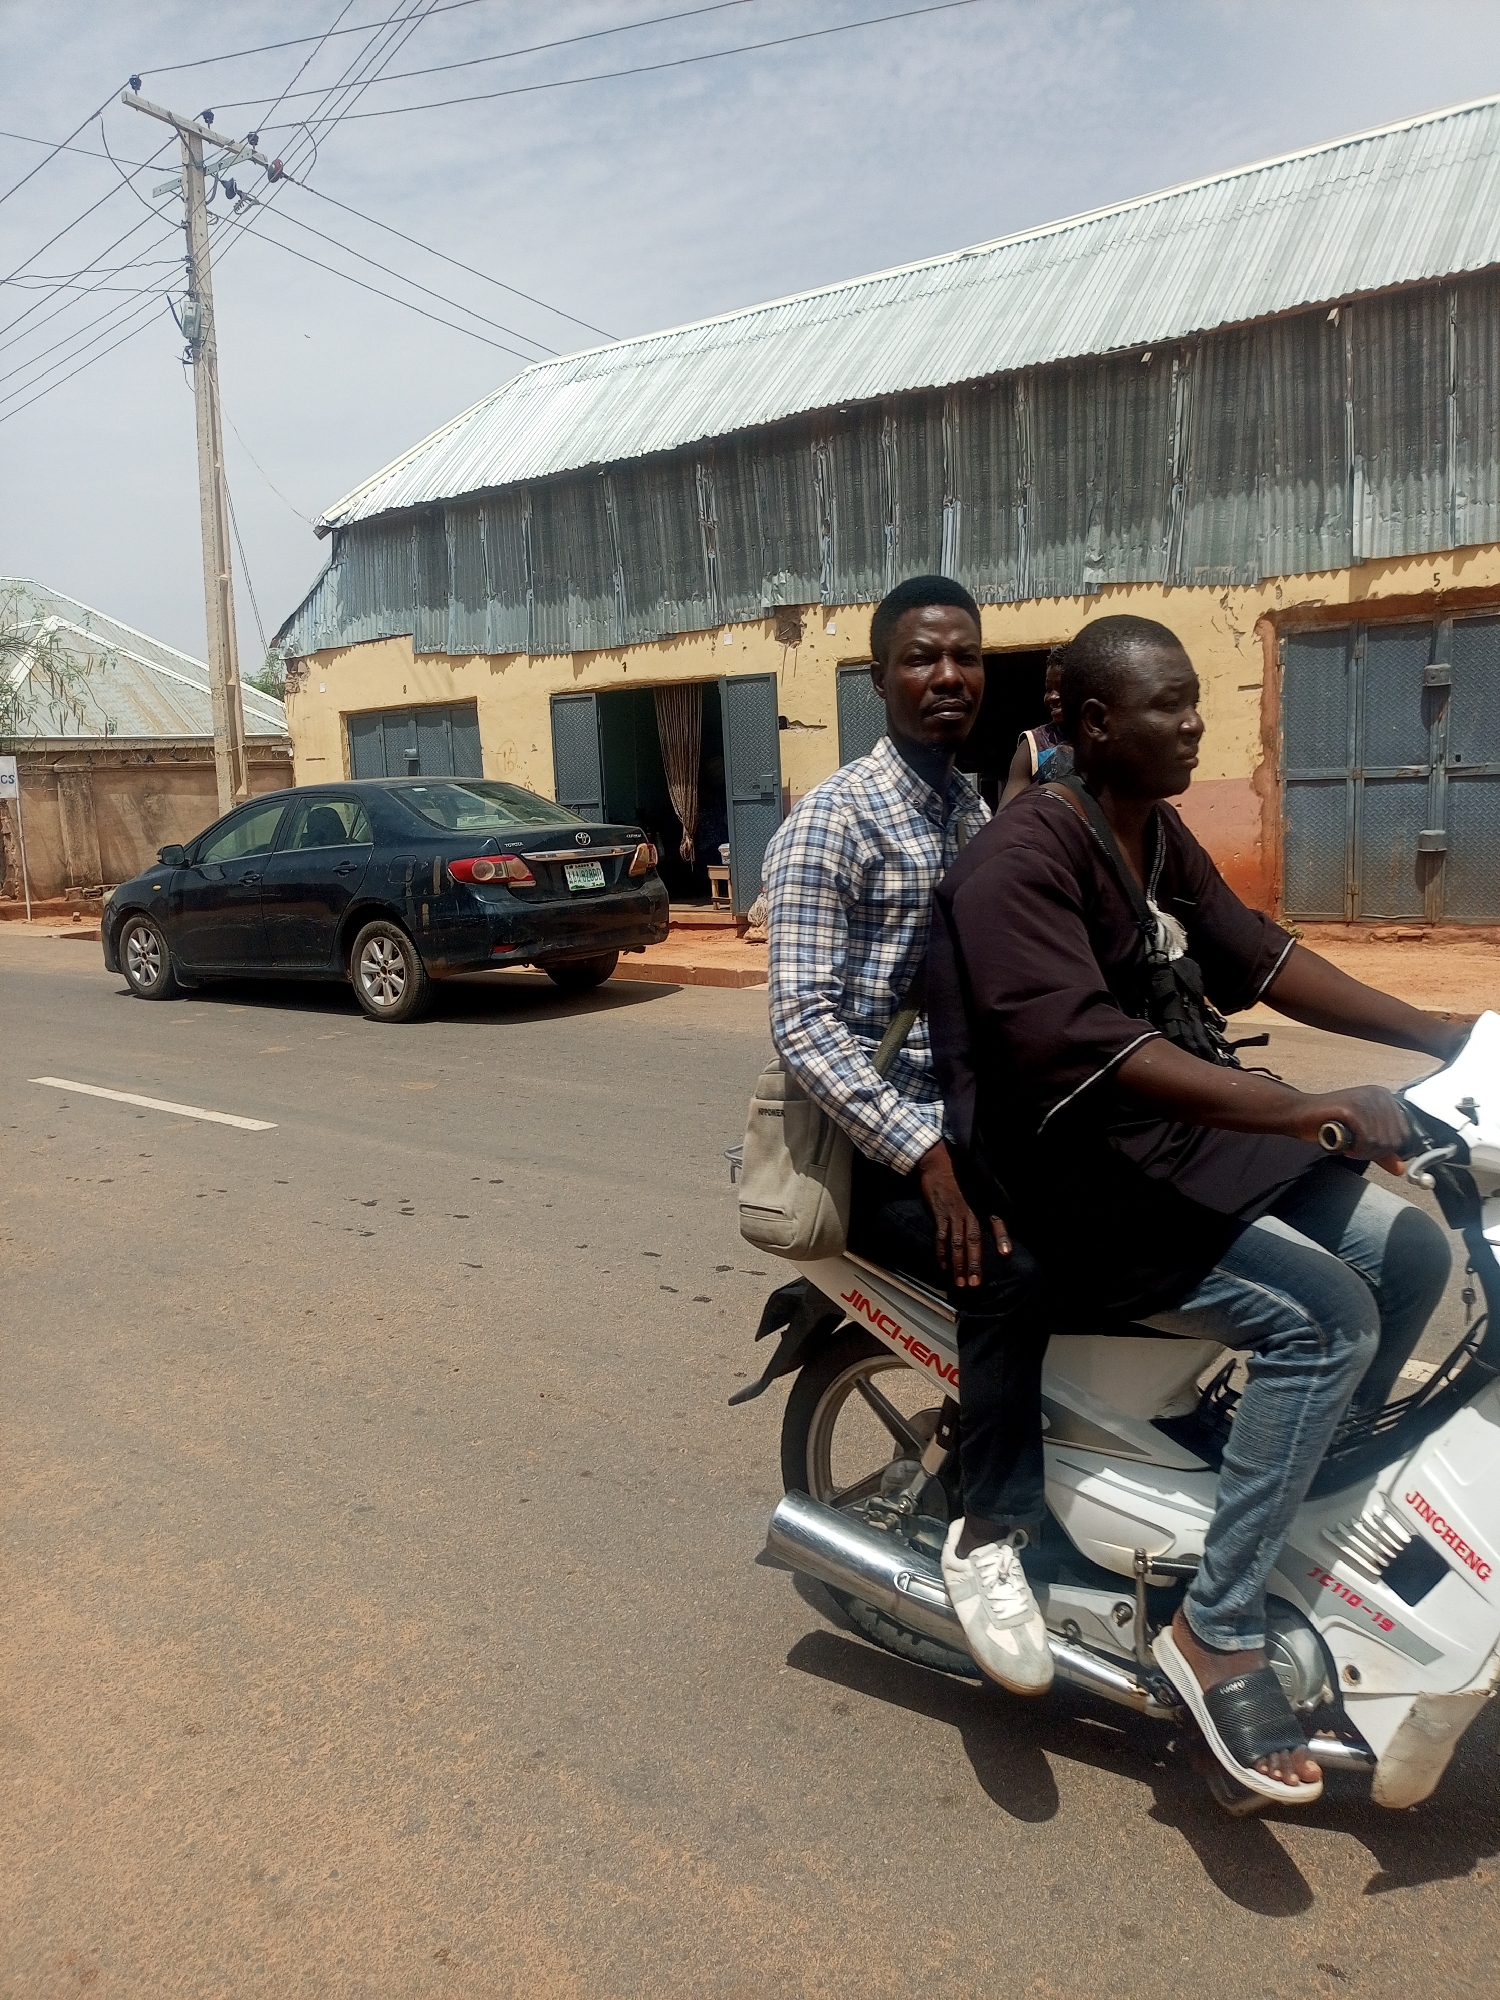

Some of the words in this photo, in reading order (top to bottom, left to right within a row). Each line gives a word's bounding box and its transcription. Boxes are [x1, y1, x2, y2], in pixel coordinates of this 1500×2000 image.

[1433, 572, 1441, 587] 5
[0, 774, 15, 784] CS
[1404, 1490, 1493, 1583] JINCHENG
[1307, 1566, 1397, 1632] JC110-19
